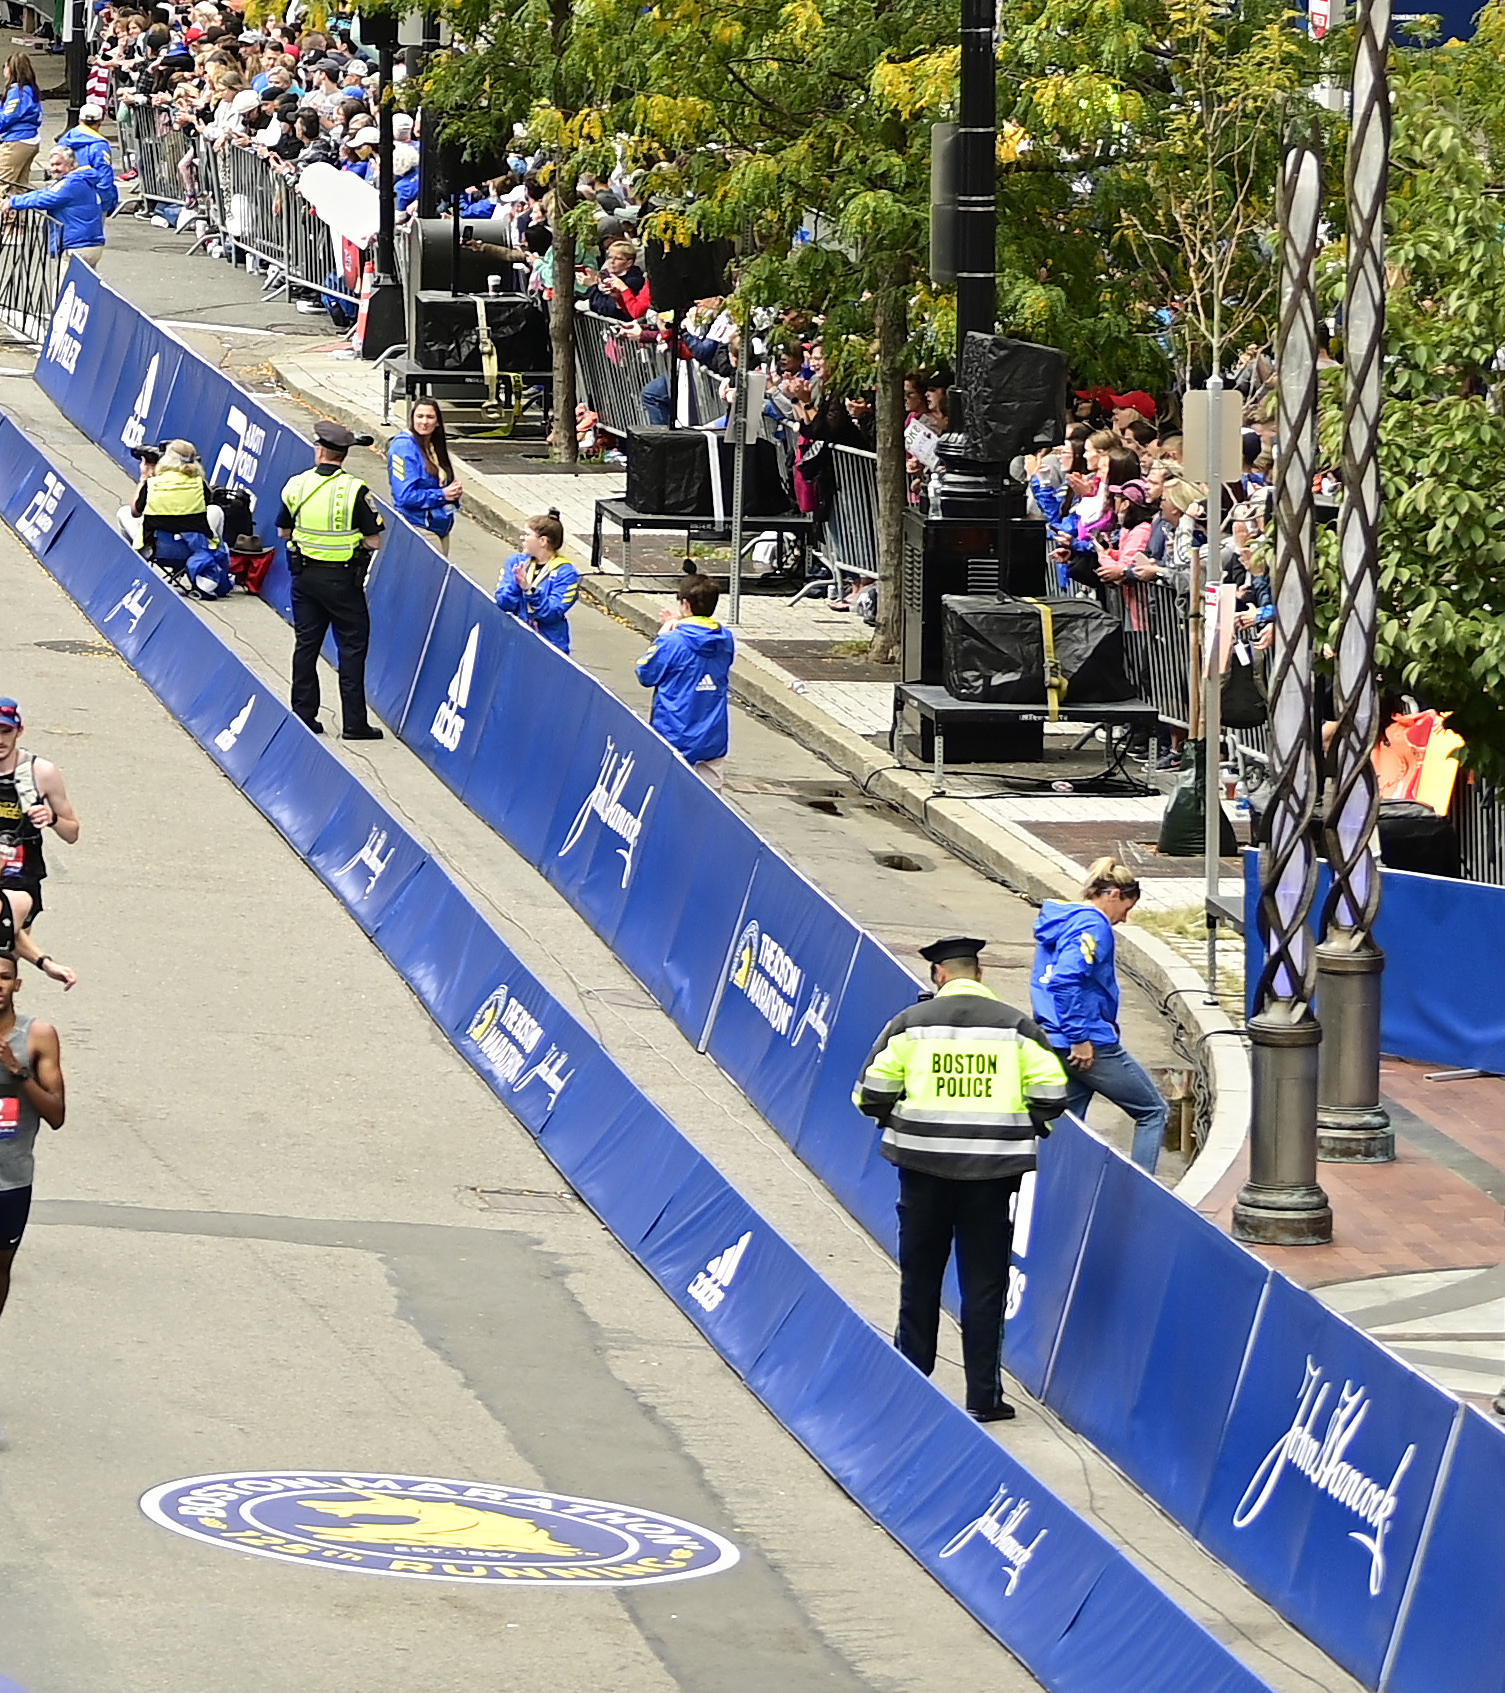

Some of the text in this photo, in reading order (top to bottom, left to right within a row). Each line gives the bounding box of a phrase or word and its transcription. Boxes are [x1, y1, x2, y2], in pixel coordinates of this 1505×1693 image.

[931, 1053, 999, 1076] BOSTON
[935, 1076, 994, 1099] POLICE
[177, 1476, 697, 1551] BOSTON MARATHON
[1308, 1379, 1417, 1596] Hancock
[220, 1528, 689, 1580] 125th RUNNING
